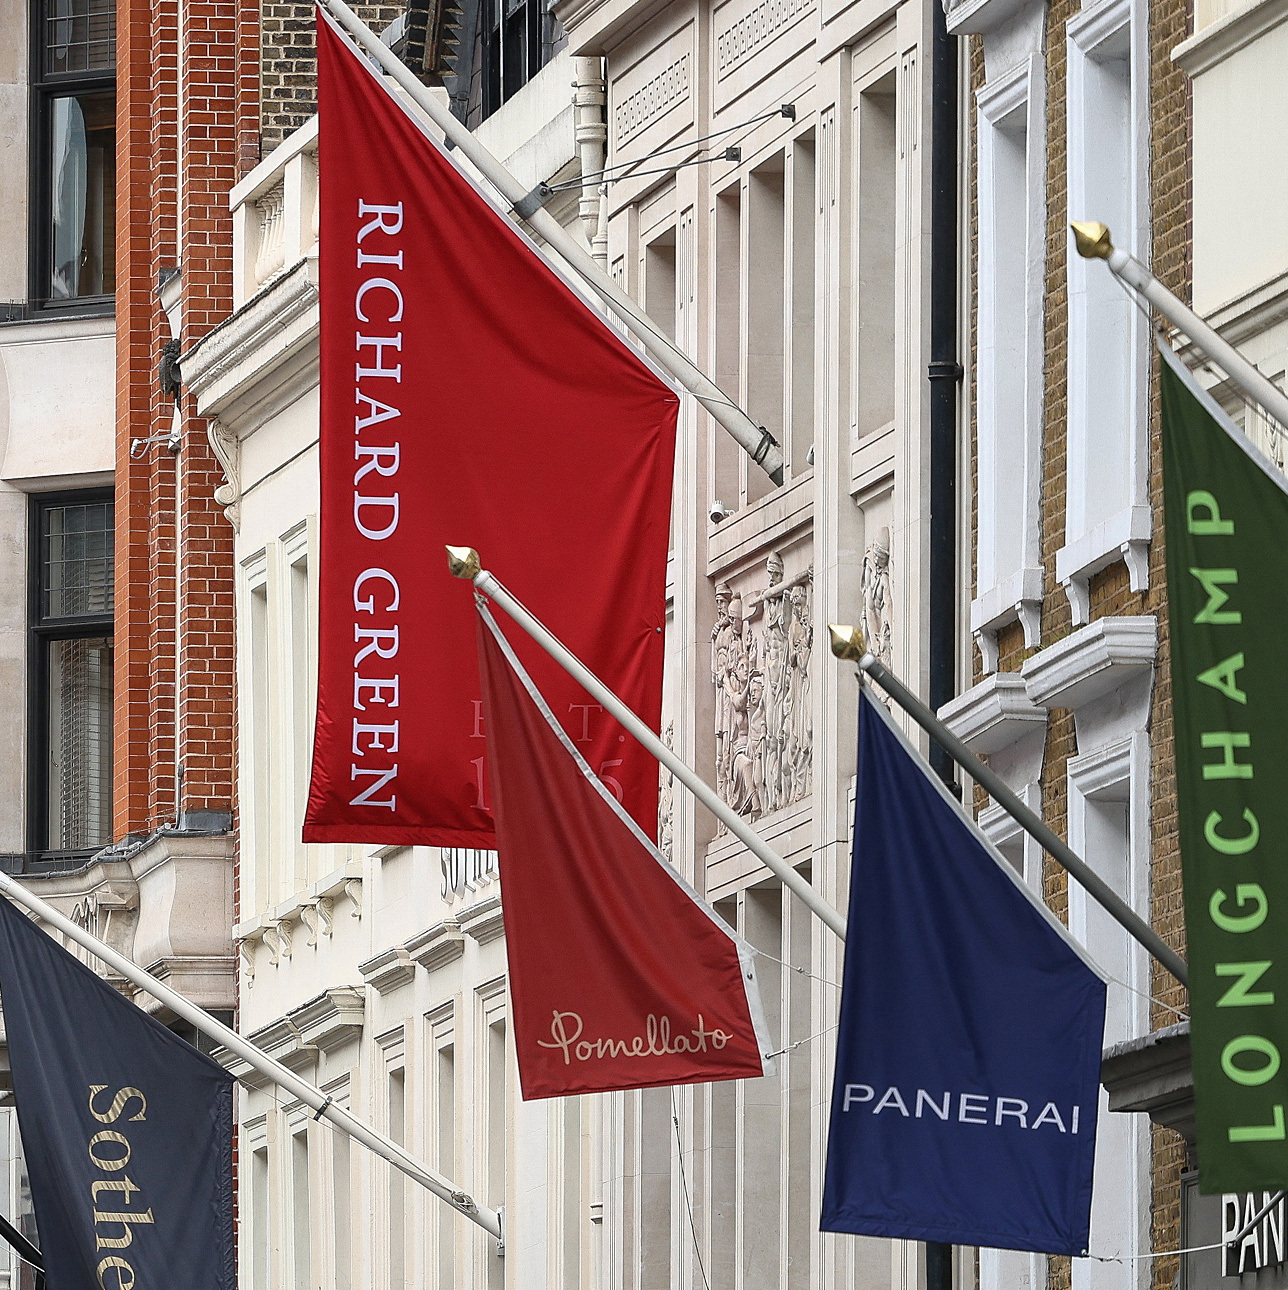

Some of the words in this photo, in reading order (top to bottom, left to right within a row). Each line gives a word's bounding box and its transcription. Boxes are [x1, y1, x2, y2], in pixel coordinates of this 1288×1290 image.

[353, 197, 404, 541] RICHARD
[349, 568, 400, 812] GREEN
[1187, 489, 1286, 1142] LONGCHAMP
[537, 1009, 734, 1066] Pomellato
[841, 1082, 1081, 1135] PANERAI
